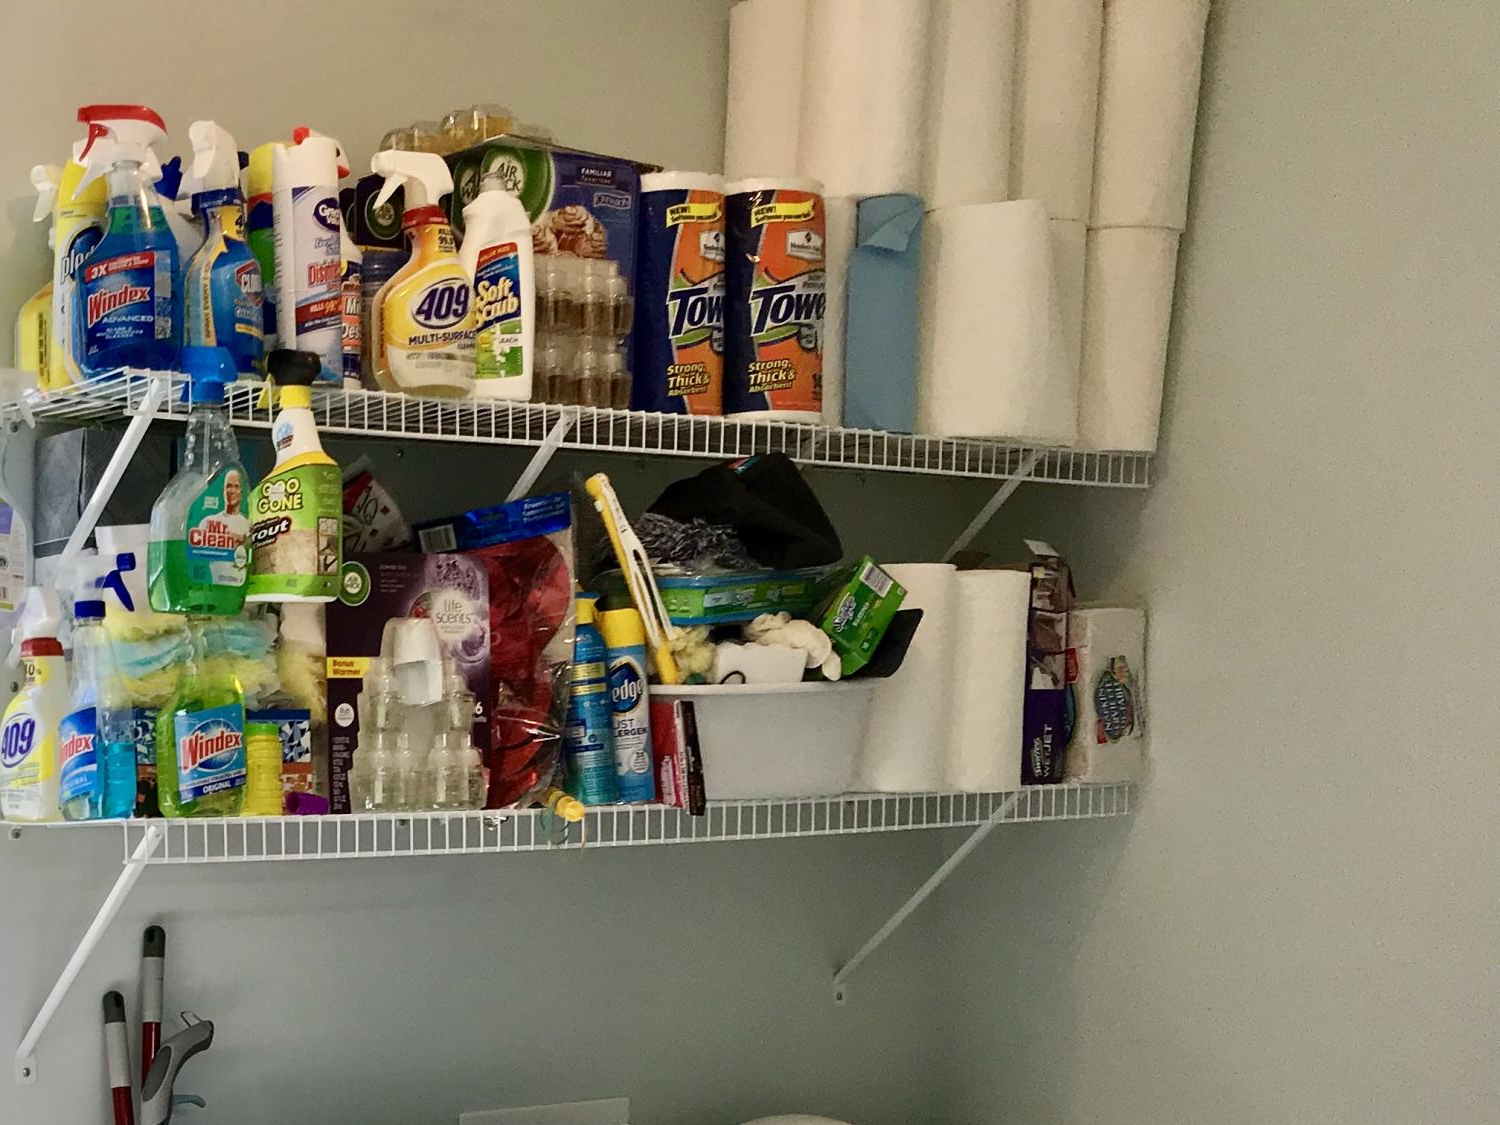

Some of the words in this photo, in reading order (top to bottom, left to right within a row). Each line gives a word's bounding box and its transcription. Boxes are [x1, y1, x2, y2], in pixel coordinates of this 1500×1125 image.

[580, 168, 612, 178] FAMILIAR
[669, 205, 691, 215] NEW!
[753, 205, 777, 215] NEW!
[91, 264, 107, 279] 3X
[478, 277, 514, 301] Soft
[87, 283, 151, 329] Windex
[415, 283, 470, 322] 409
[476, 291, 519, 326] Scrub
[102, 314, 154, 324] ADVANCED
[668, 385, 707, 397] Absorbent
[749, 381, 793, 393] Absorbent
[257, 494, 303, 514] GONE
[207, 519, 230, 535] Mr.
[251, 519, 290, 543] rout
[189, 529, 236, 549] Clean
[443, 599, 462, 614] life
[436, 612, 471, 625] scents
[332, 659, 355, 668] Bonus
[332, 667, 361, 676] Warmer
[612, 677, 645, 703] edge
[475, 701, 484, 715] 6
[1, 718, 36, 760] 409
[181, 730, 243, 774] Windex
